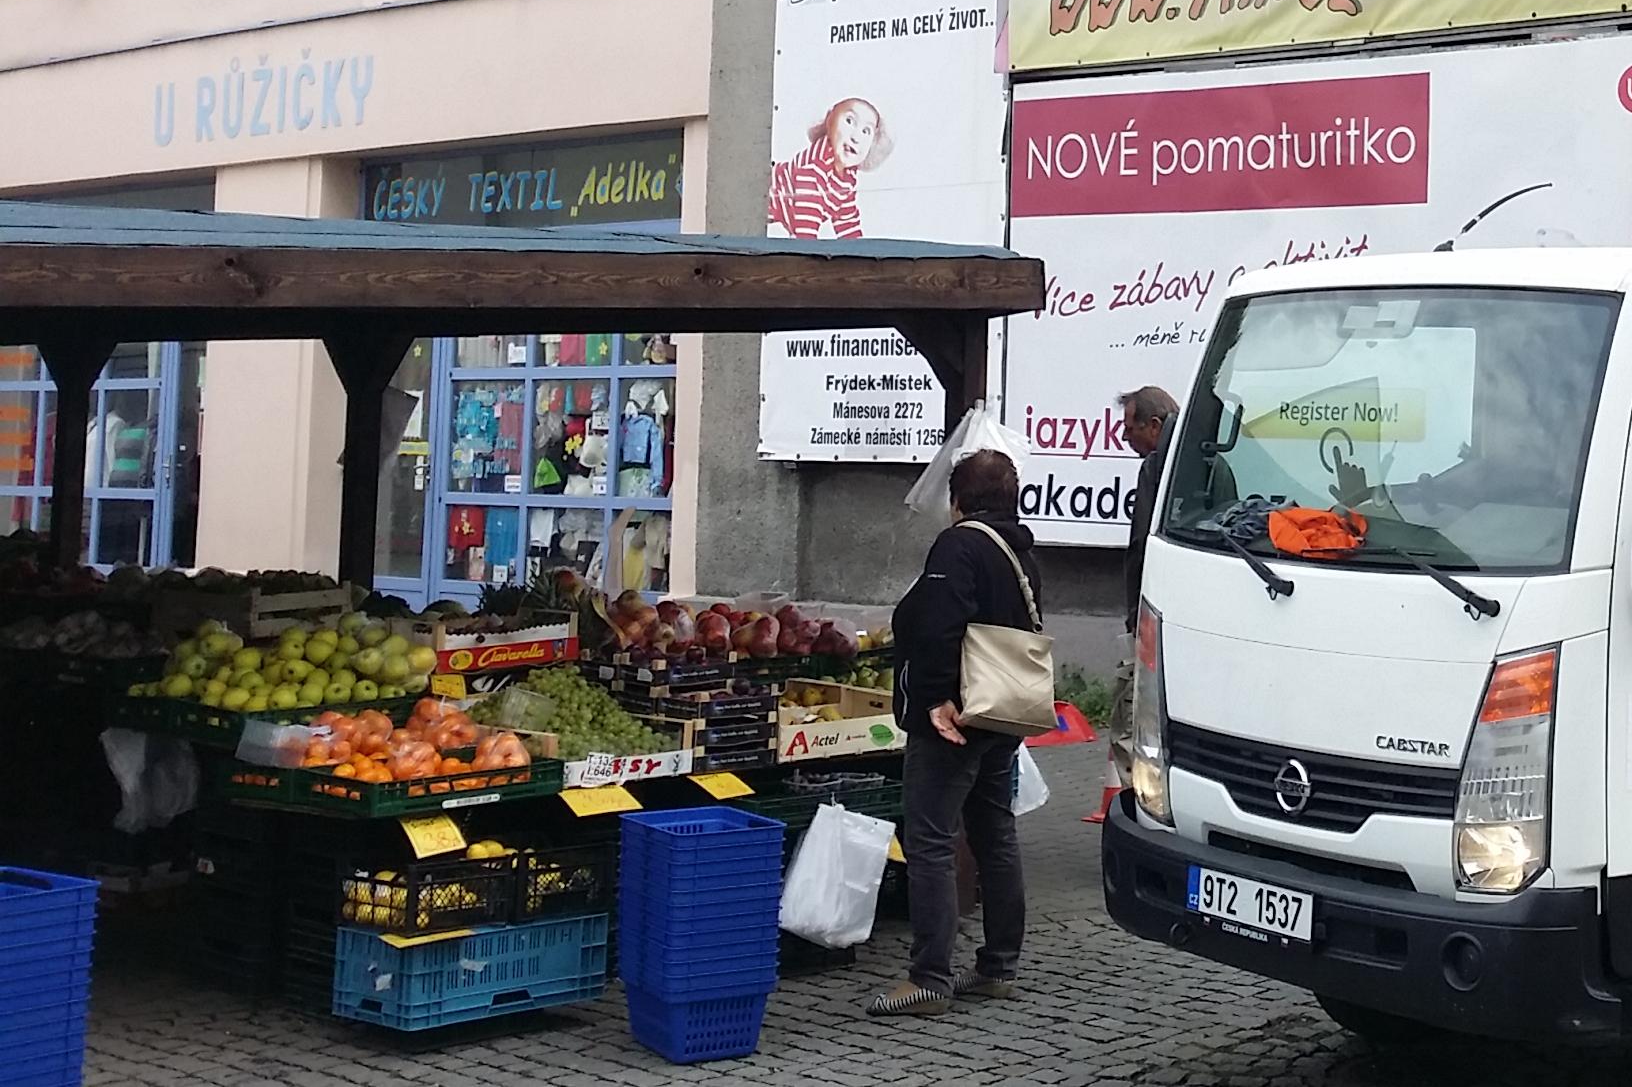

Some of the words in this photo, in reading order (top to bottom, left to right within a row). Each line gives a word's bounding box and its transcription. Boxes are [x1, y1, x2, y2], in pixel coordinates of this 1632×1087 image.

[830, 20, 886, 44] PARTNER
[891, 17, 908, 37] NA
[913, 8, 944, 35] CELÝ
[153, 82, 177, 147] U
[195, 47, 376, 143] RŮŽIČKY
[1027, 119, 1138, 180] NOVÉ
[1152, 116, 1416, 185] pomaturitko
[372, 164, 447, 223] ČESKÝ
[467, 167, 564, 214] TEXTIL
[1109, 262, 1214, 311] zábavy
[1133, 322, 1184, 347] méně
[825, 373, 933, 392] Frýdek-Místek
[832, 402, 890, 420] Mánesova
[894, 402, 923, 420] 2272
[1280, 402, 1348, 426] Register
[1354, 402, 1398, 423] Now!
[810, 427, 861, 445] Zámecké
[865, 427, 911, 446] náměstí
[916, 428, 945, 446] 1256
[811, 733, 839, 747] Actel
[1376, 735, 1450, 758] CABSTAR
[1189, 893, 1199, 905] CZ
[1203, 874, 1238, 915] 9T2
[1255, 887, 1302, 931] 1537
